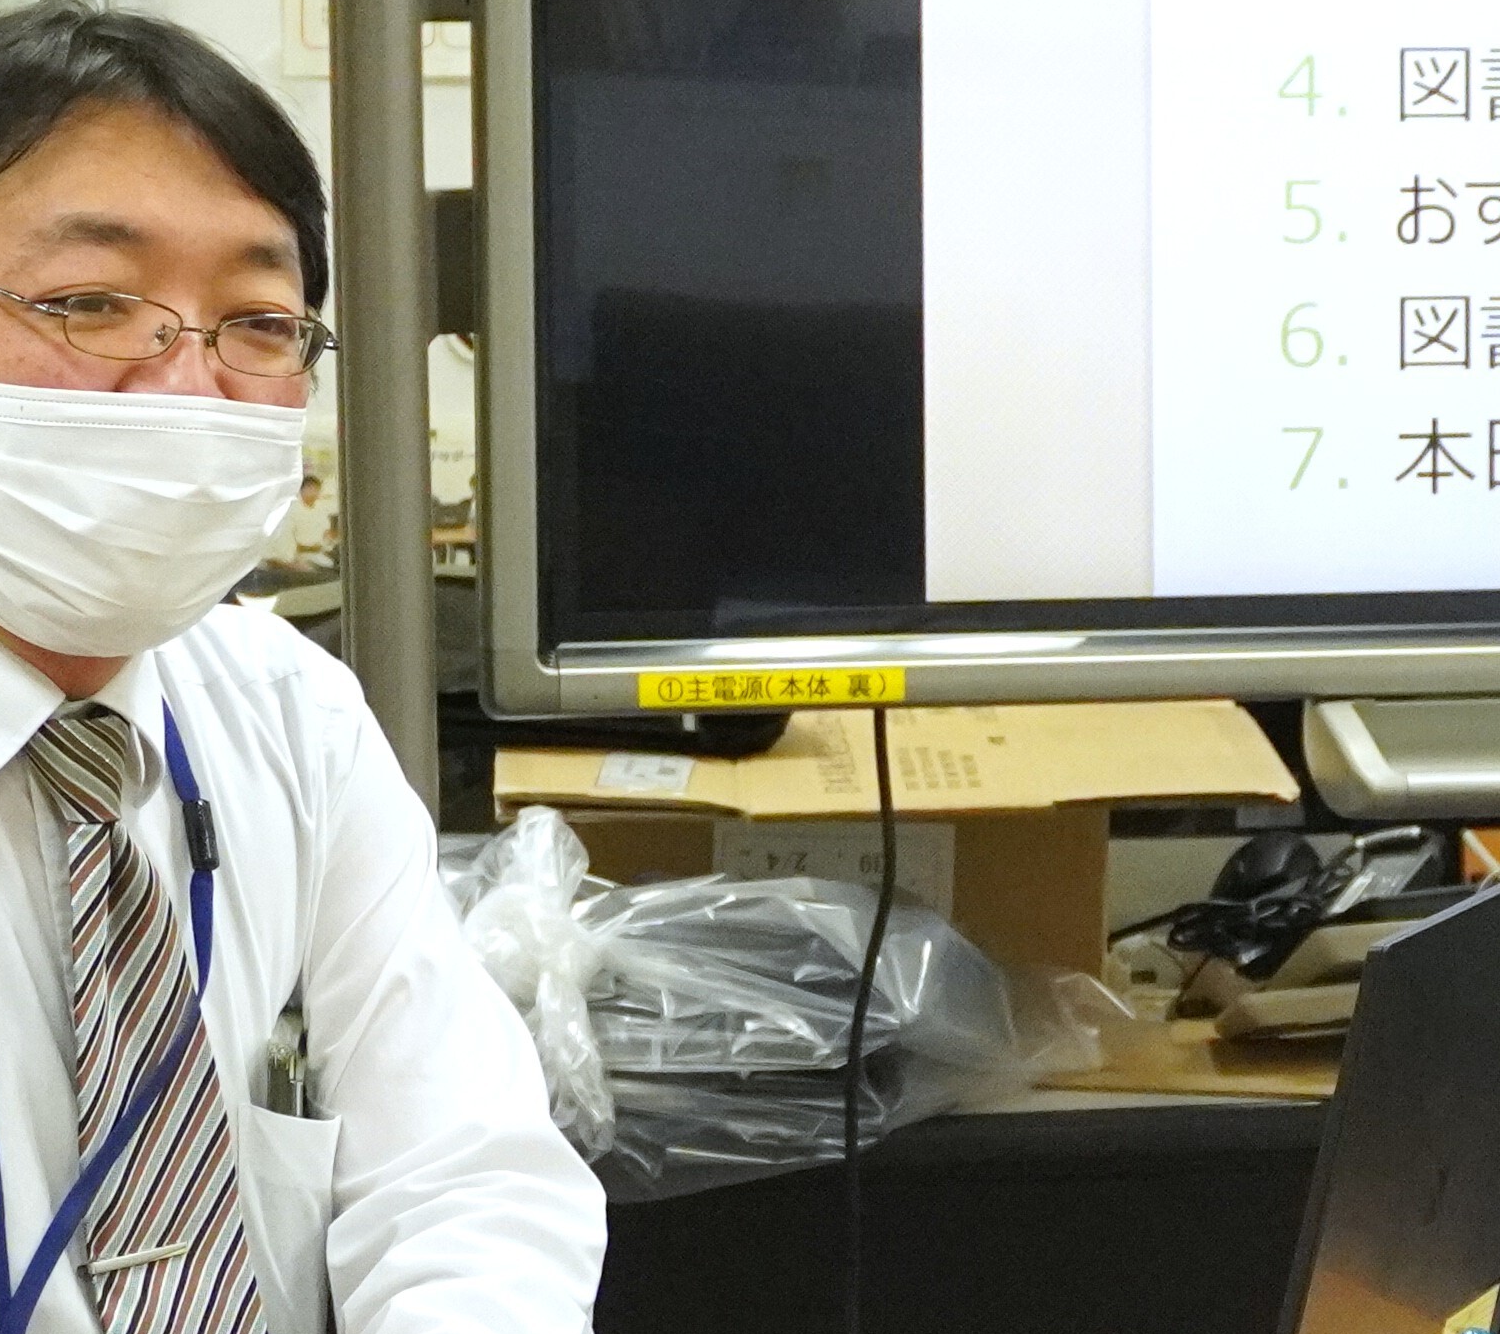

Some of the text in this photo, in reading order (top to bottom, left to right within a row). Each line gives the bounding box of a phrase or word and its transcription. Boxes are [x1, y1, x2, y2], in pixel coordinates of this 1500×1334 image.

[1277, 53, 1348, 118] 4.
[1283, 178, 1348, 246] 5.
[1280, 300, 1349, 370] 6.
[1281, 425, 1348, 492] 7.
